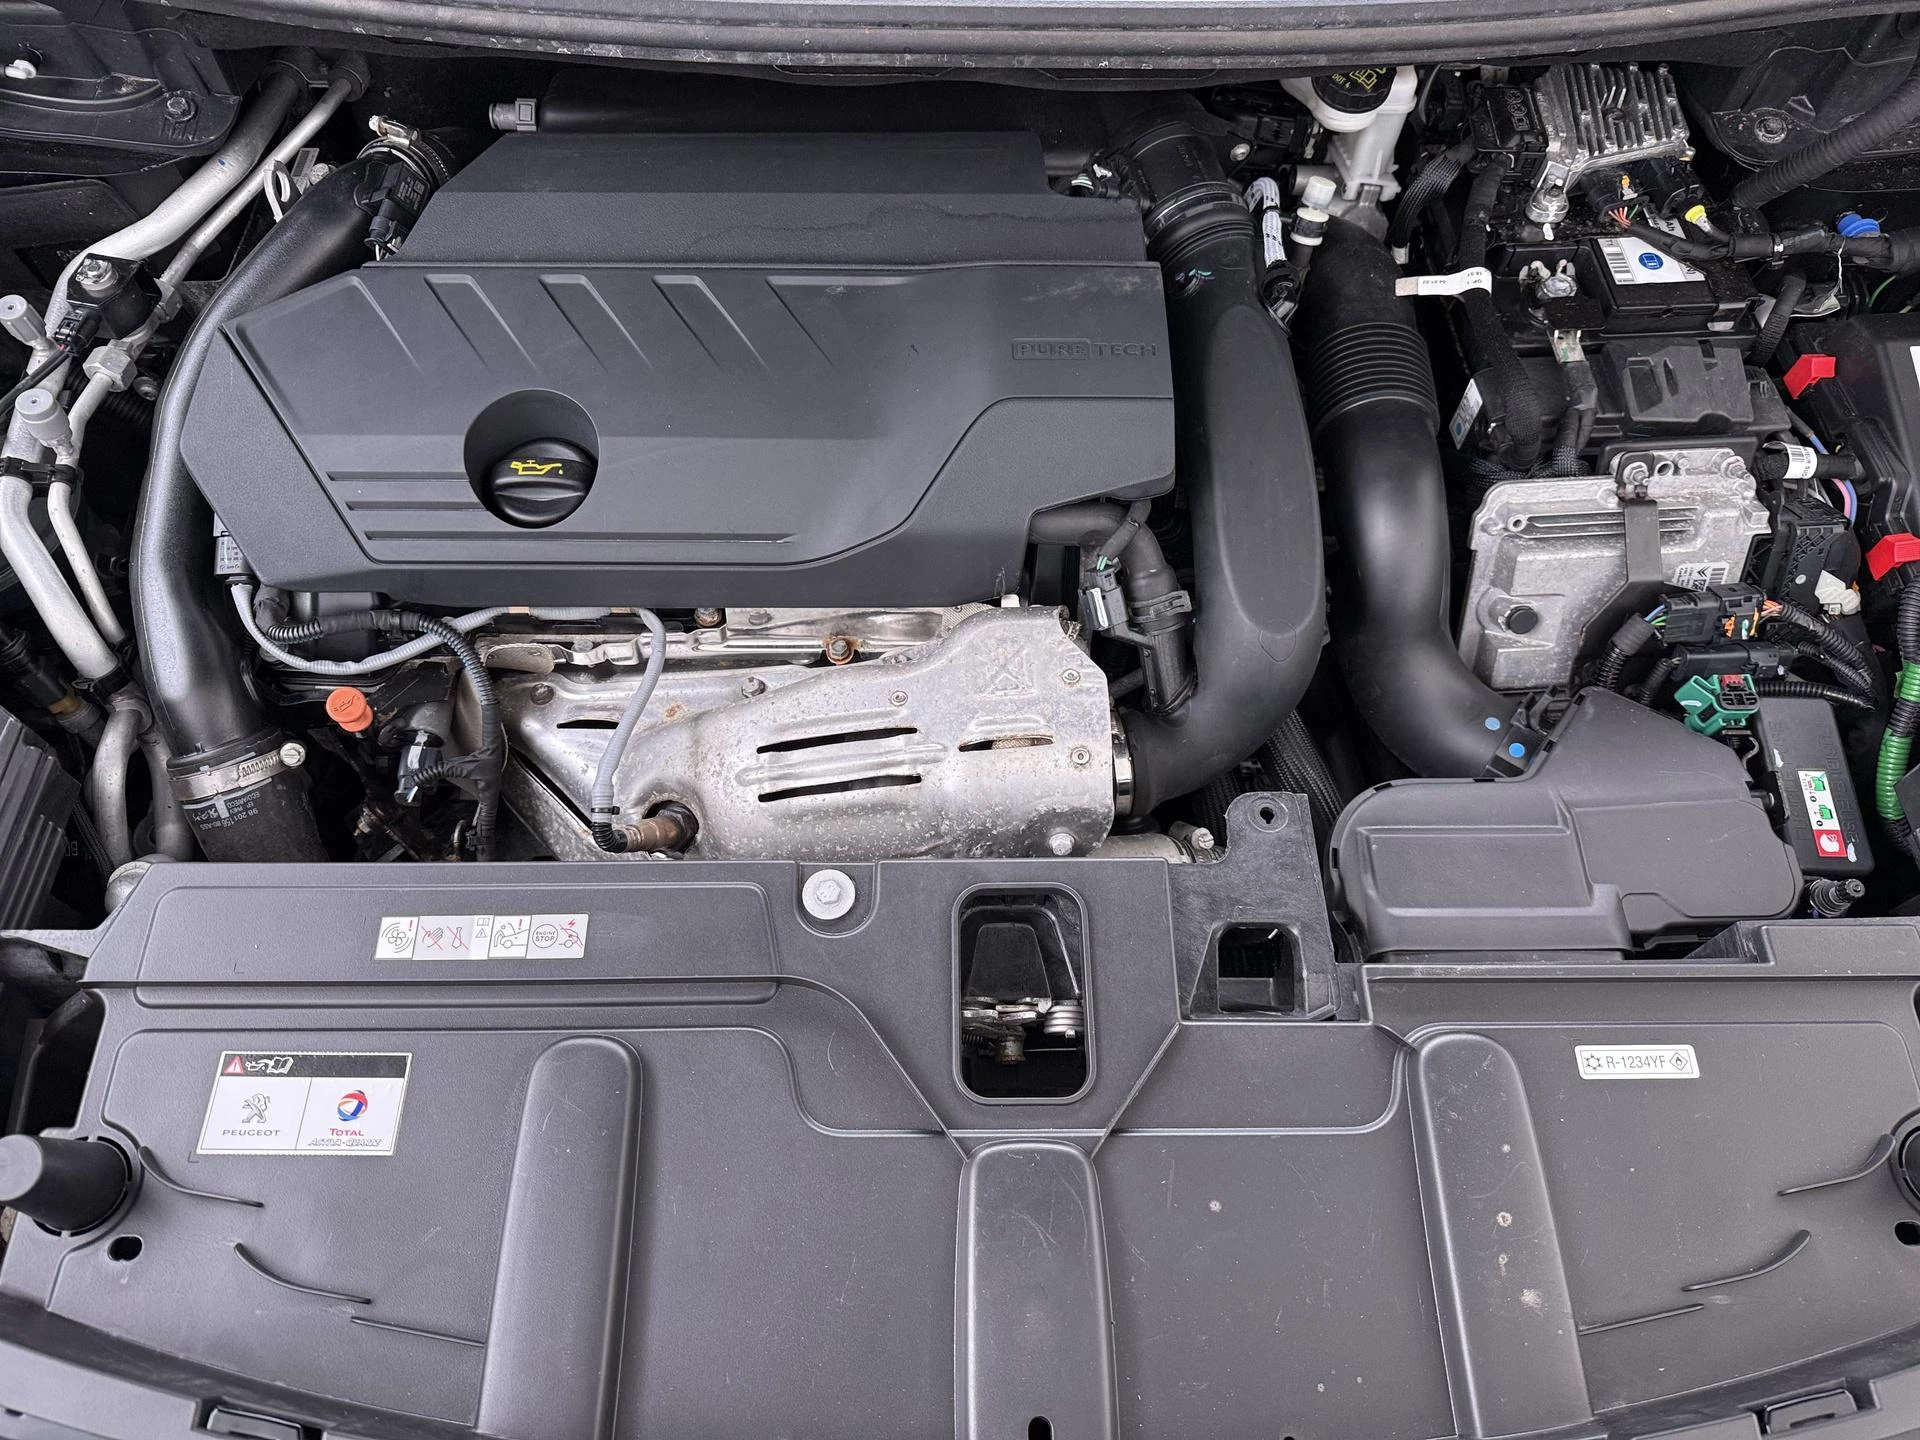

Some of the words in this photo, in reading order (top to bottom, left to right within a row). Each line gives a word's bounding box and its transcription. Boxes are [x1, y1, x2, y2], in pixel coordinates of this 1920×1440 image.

[1018, 343, 1086, 356] PURE
[1094, 342, 1157, 356] TECH
[1605, 1055, 1666, 1069] R-1234YF
[222, 1129, 281, 1137] PEUGEOT
[329, 1127, 365, 1137] TOTAL
